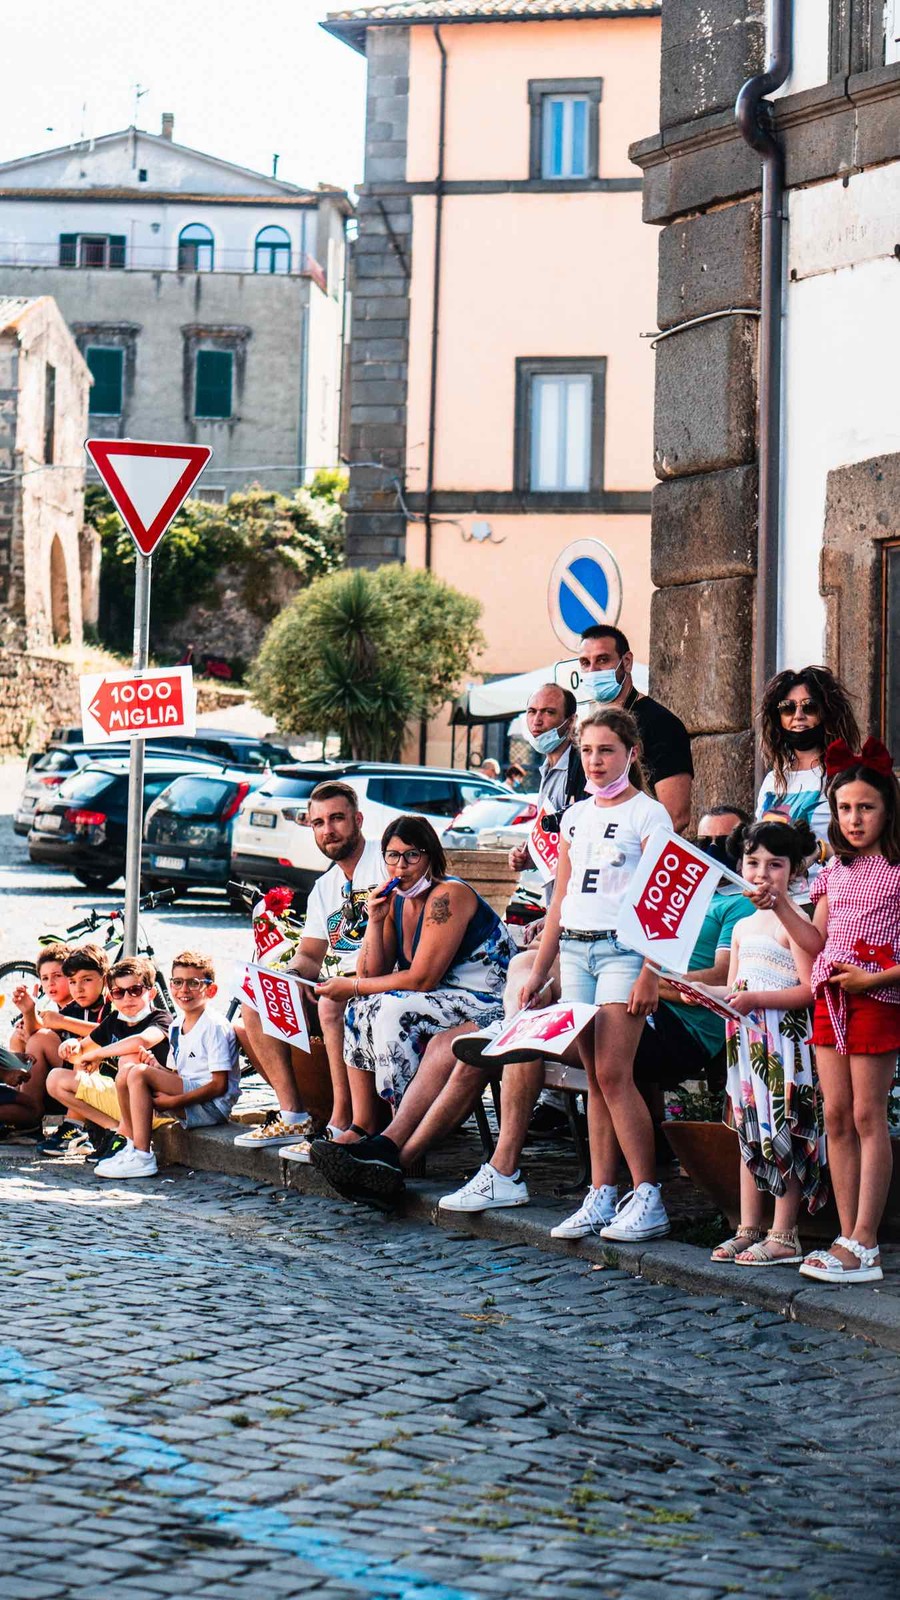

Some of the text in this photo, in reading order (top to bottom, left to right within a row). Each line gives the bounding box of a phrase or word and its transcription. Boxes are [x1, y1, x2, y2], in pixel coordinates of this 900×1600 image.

[110, 681, 172, 704] 1000
[109, 705, 178, 728] MIGLIA
[644, 853, 680, 912] 1000
[661, 862, 704, 932] MIGLIA
[262, 978, 281, 1018] 1000
[276, 981, 297, 1028] MIGLIA
